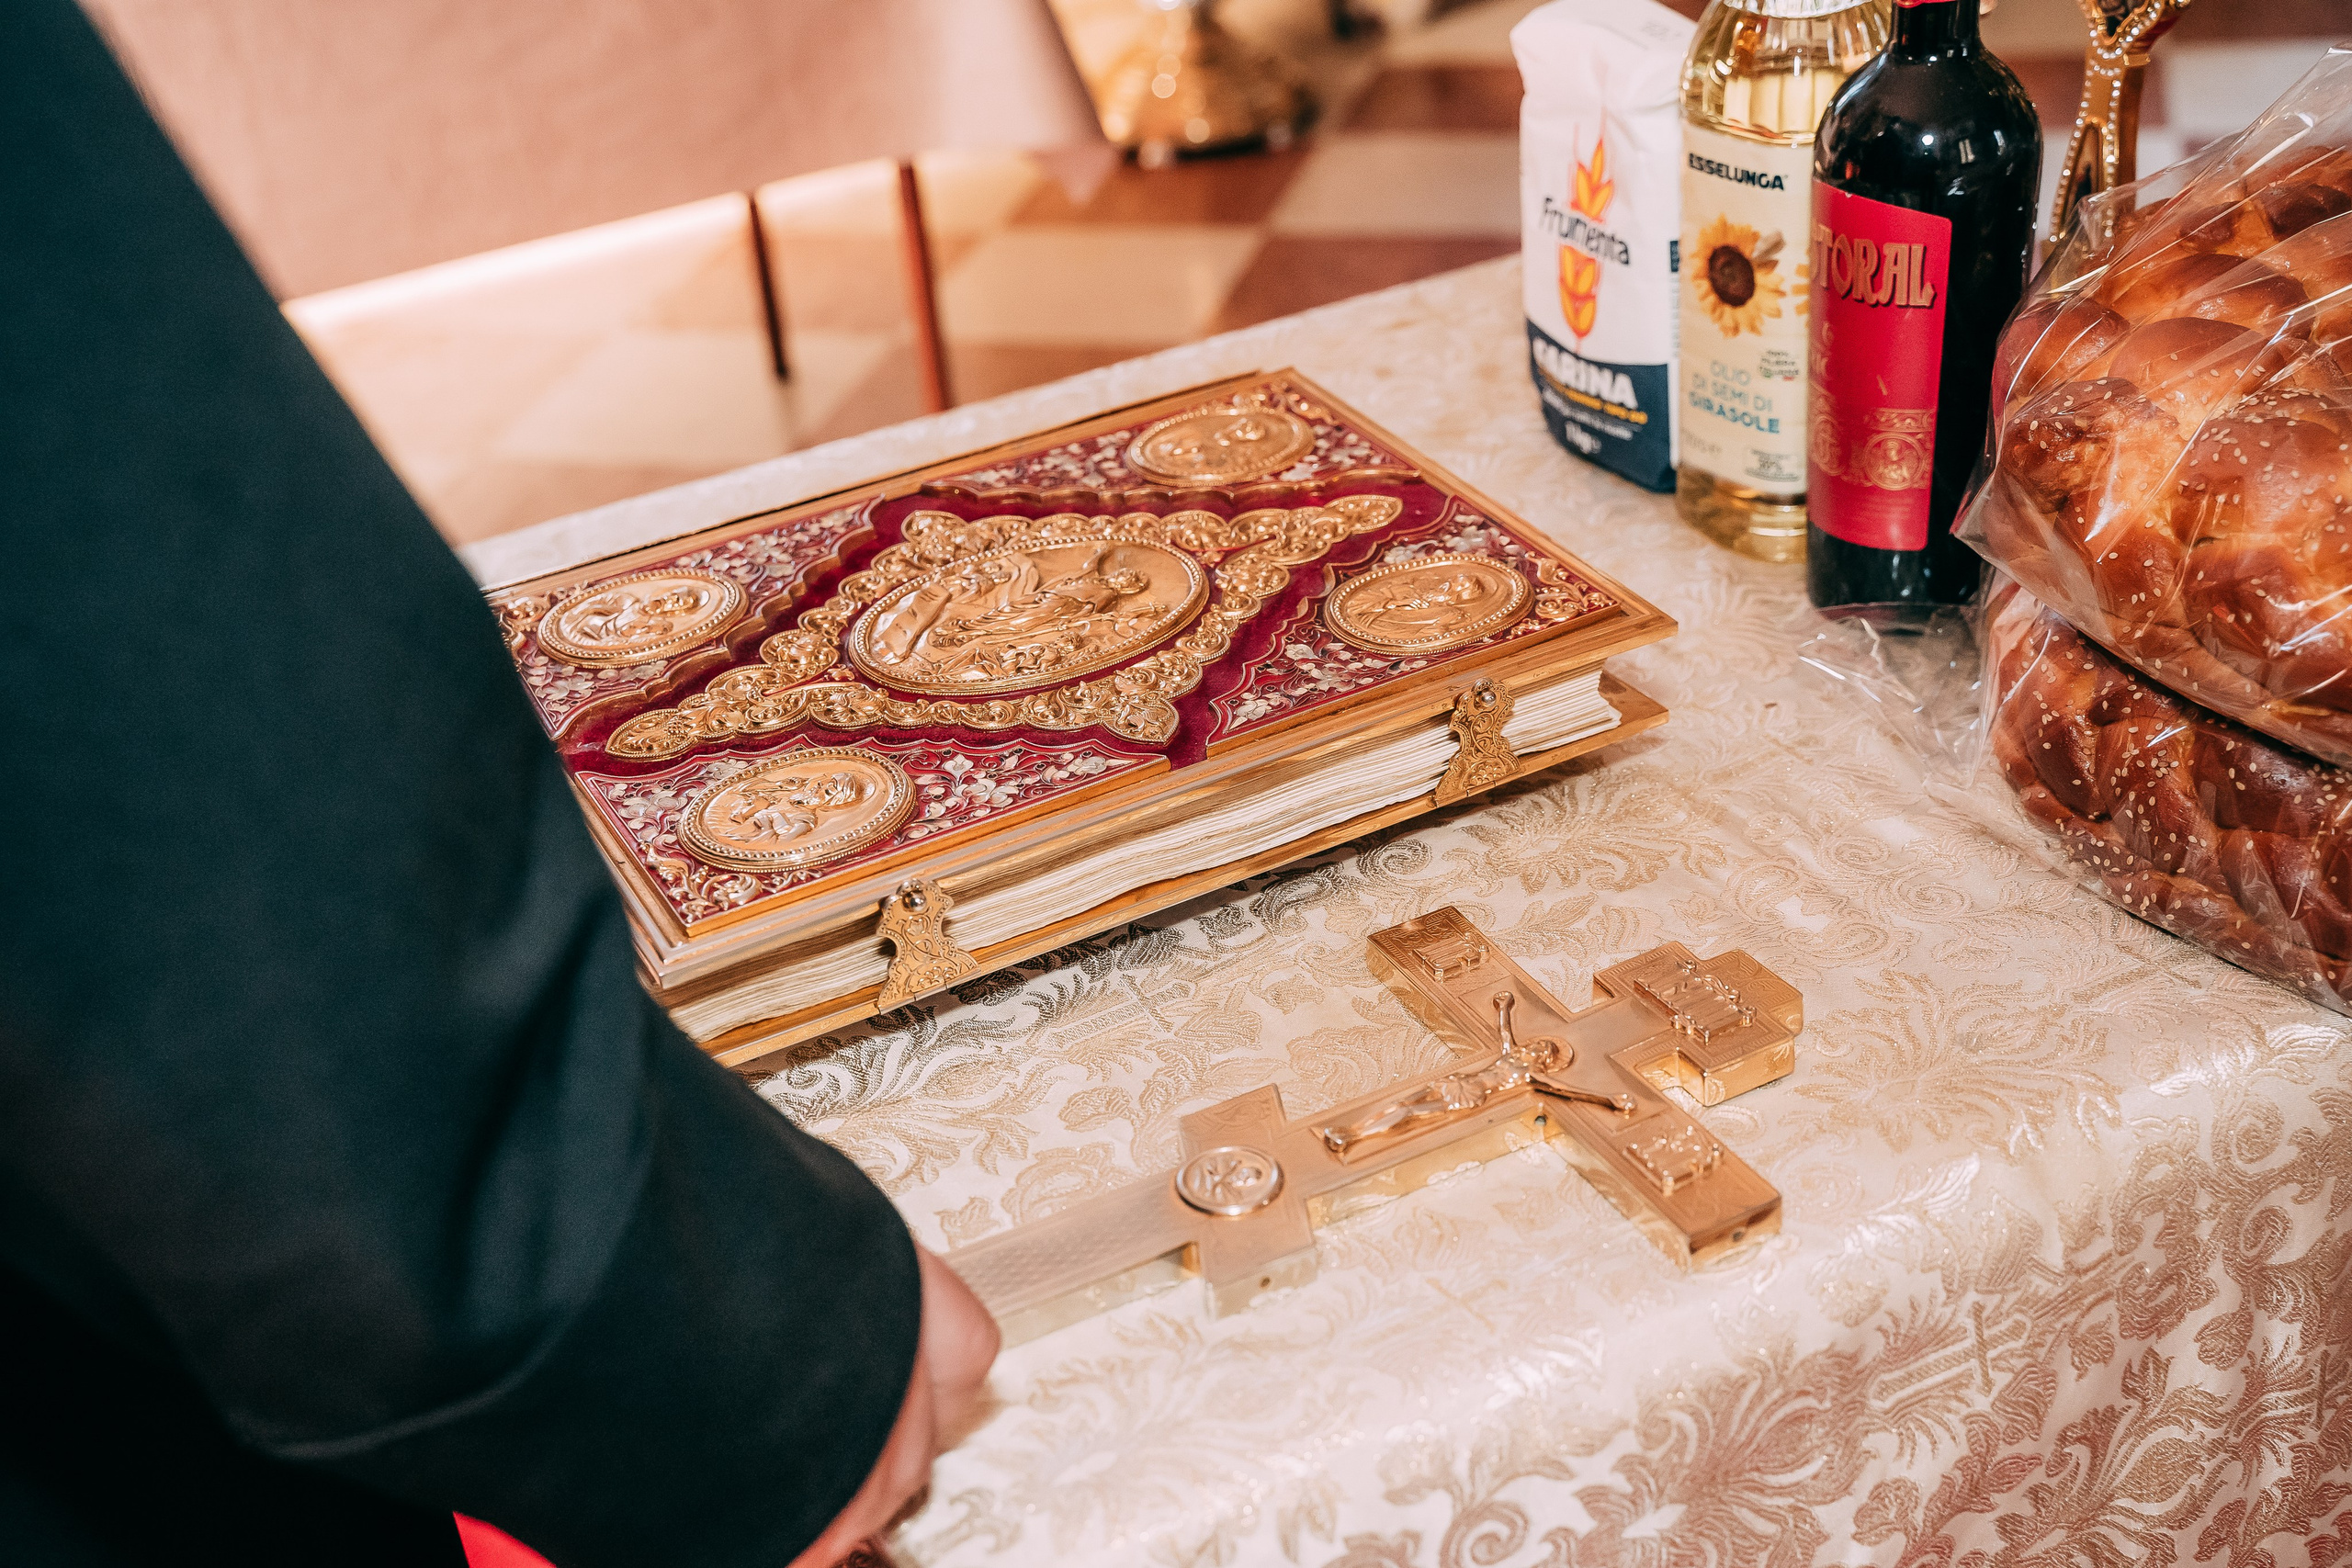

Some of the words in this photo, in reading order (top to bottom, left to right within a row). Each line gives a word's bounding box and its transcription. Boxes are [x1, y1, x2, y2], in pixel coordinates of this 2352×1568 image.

[1689, 152, 1785, 191] ESSELUNGA
[1539, 197, 1630, 265] Frumenta
[1710, 359, 1751, 387] OLIO
[1689, 390, 1781, 434] GIRASOLE
[1753, 394, 1773, 412] DI
